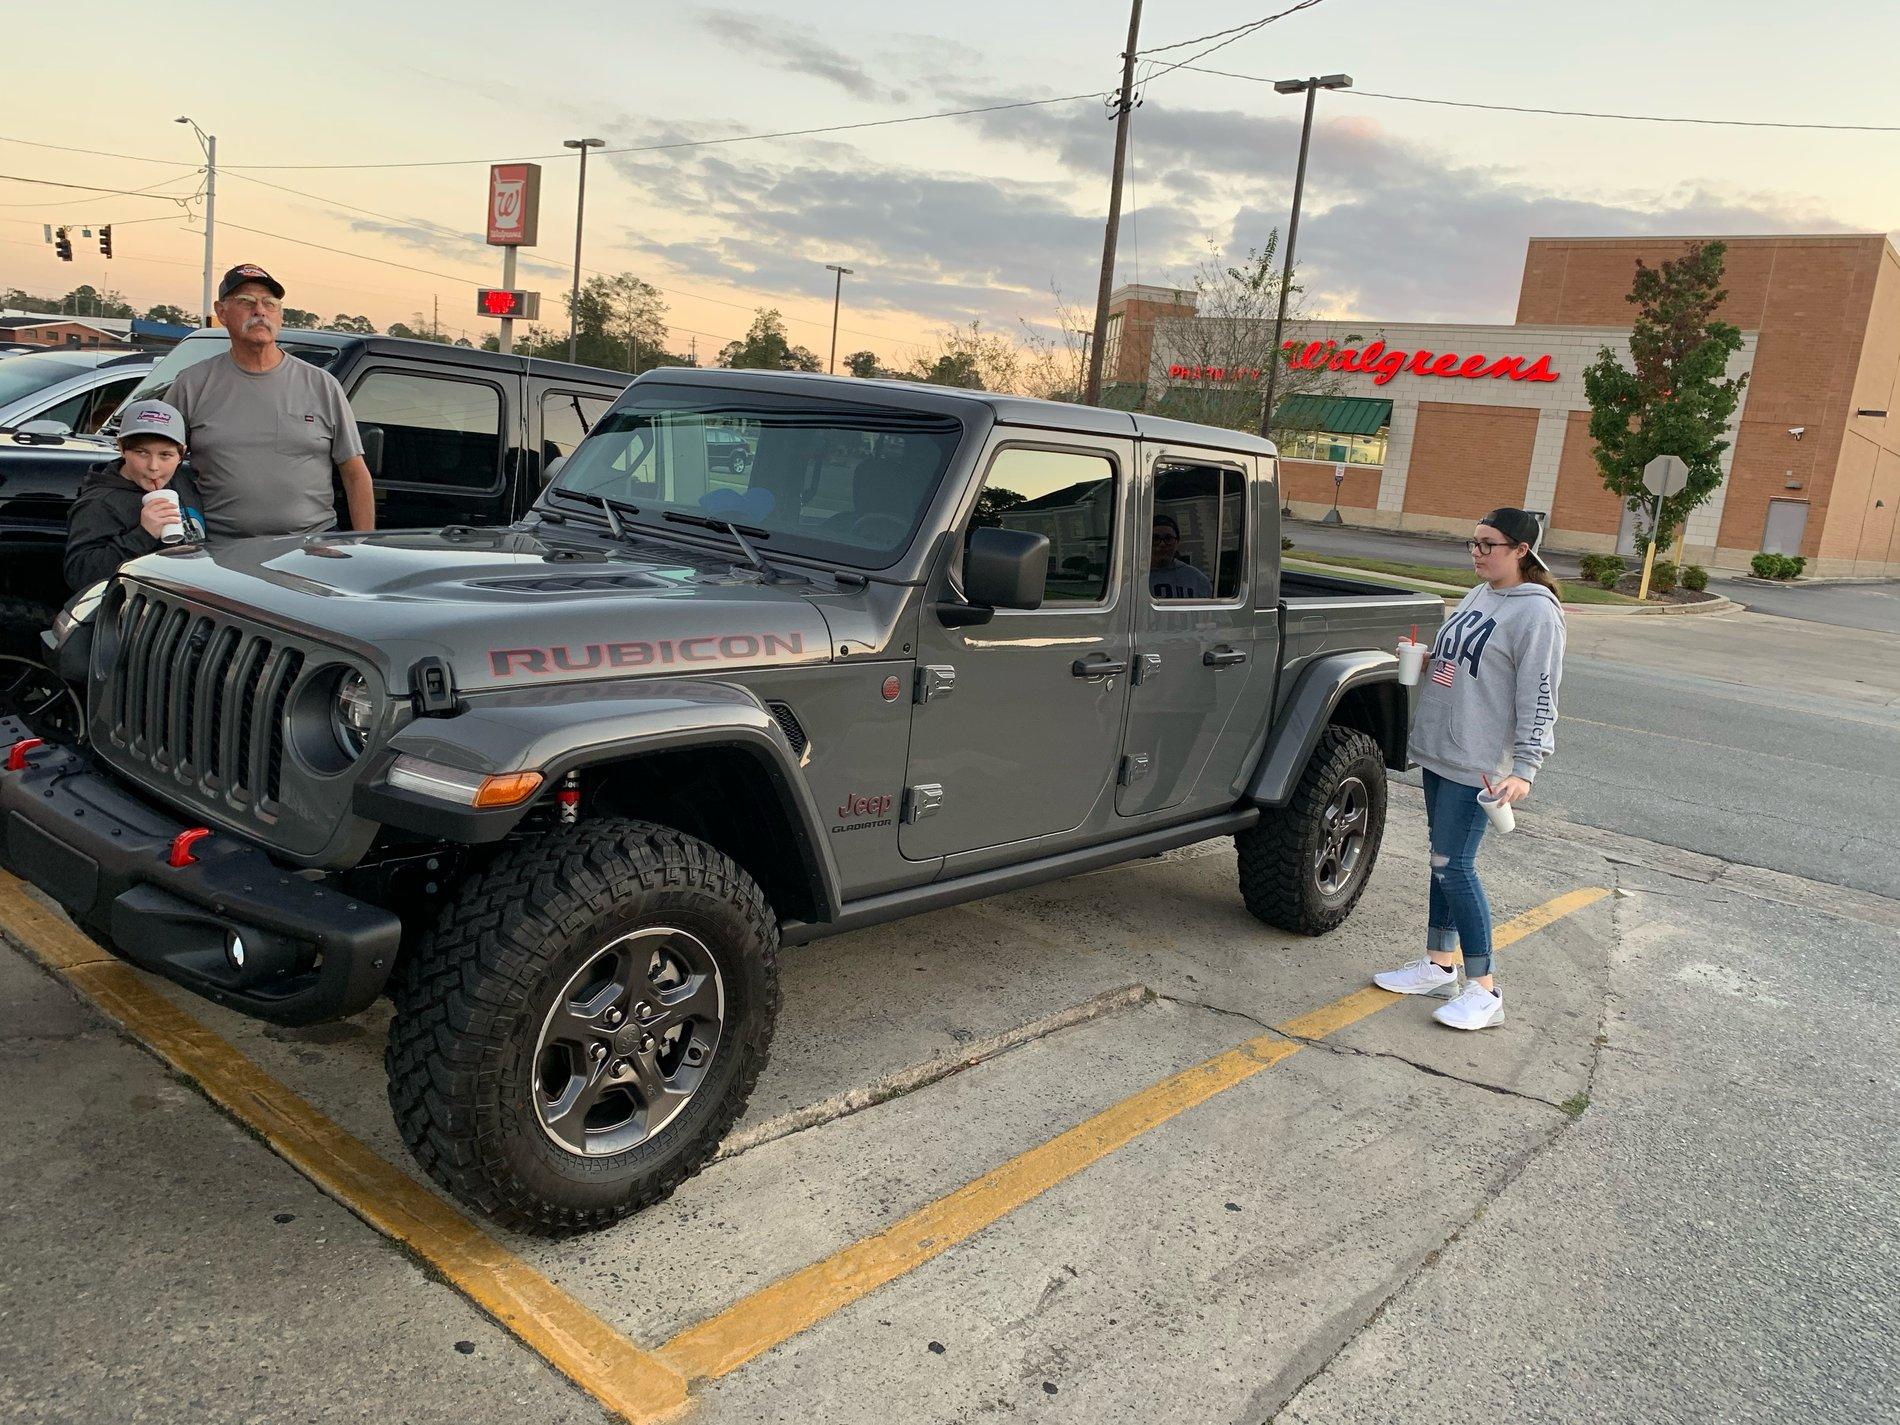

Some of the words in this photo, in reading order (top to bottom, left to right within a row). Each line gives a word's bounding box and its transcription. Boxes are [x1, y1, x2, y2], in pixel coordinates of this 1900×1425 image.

[1169, 364, 1262, 380] PHARMY
[1281, 340, 1560, 385] Walgreens
[488, 632, 804, 678] RUBICON
[837, 792, 893, 819] Jeep
[831, 819, 892, 833] GLADIATOR
